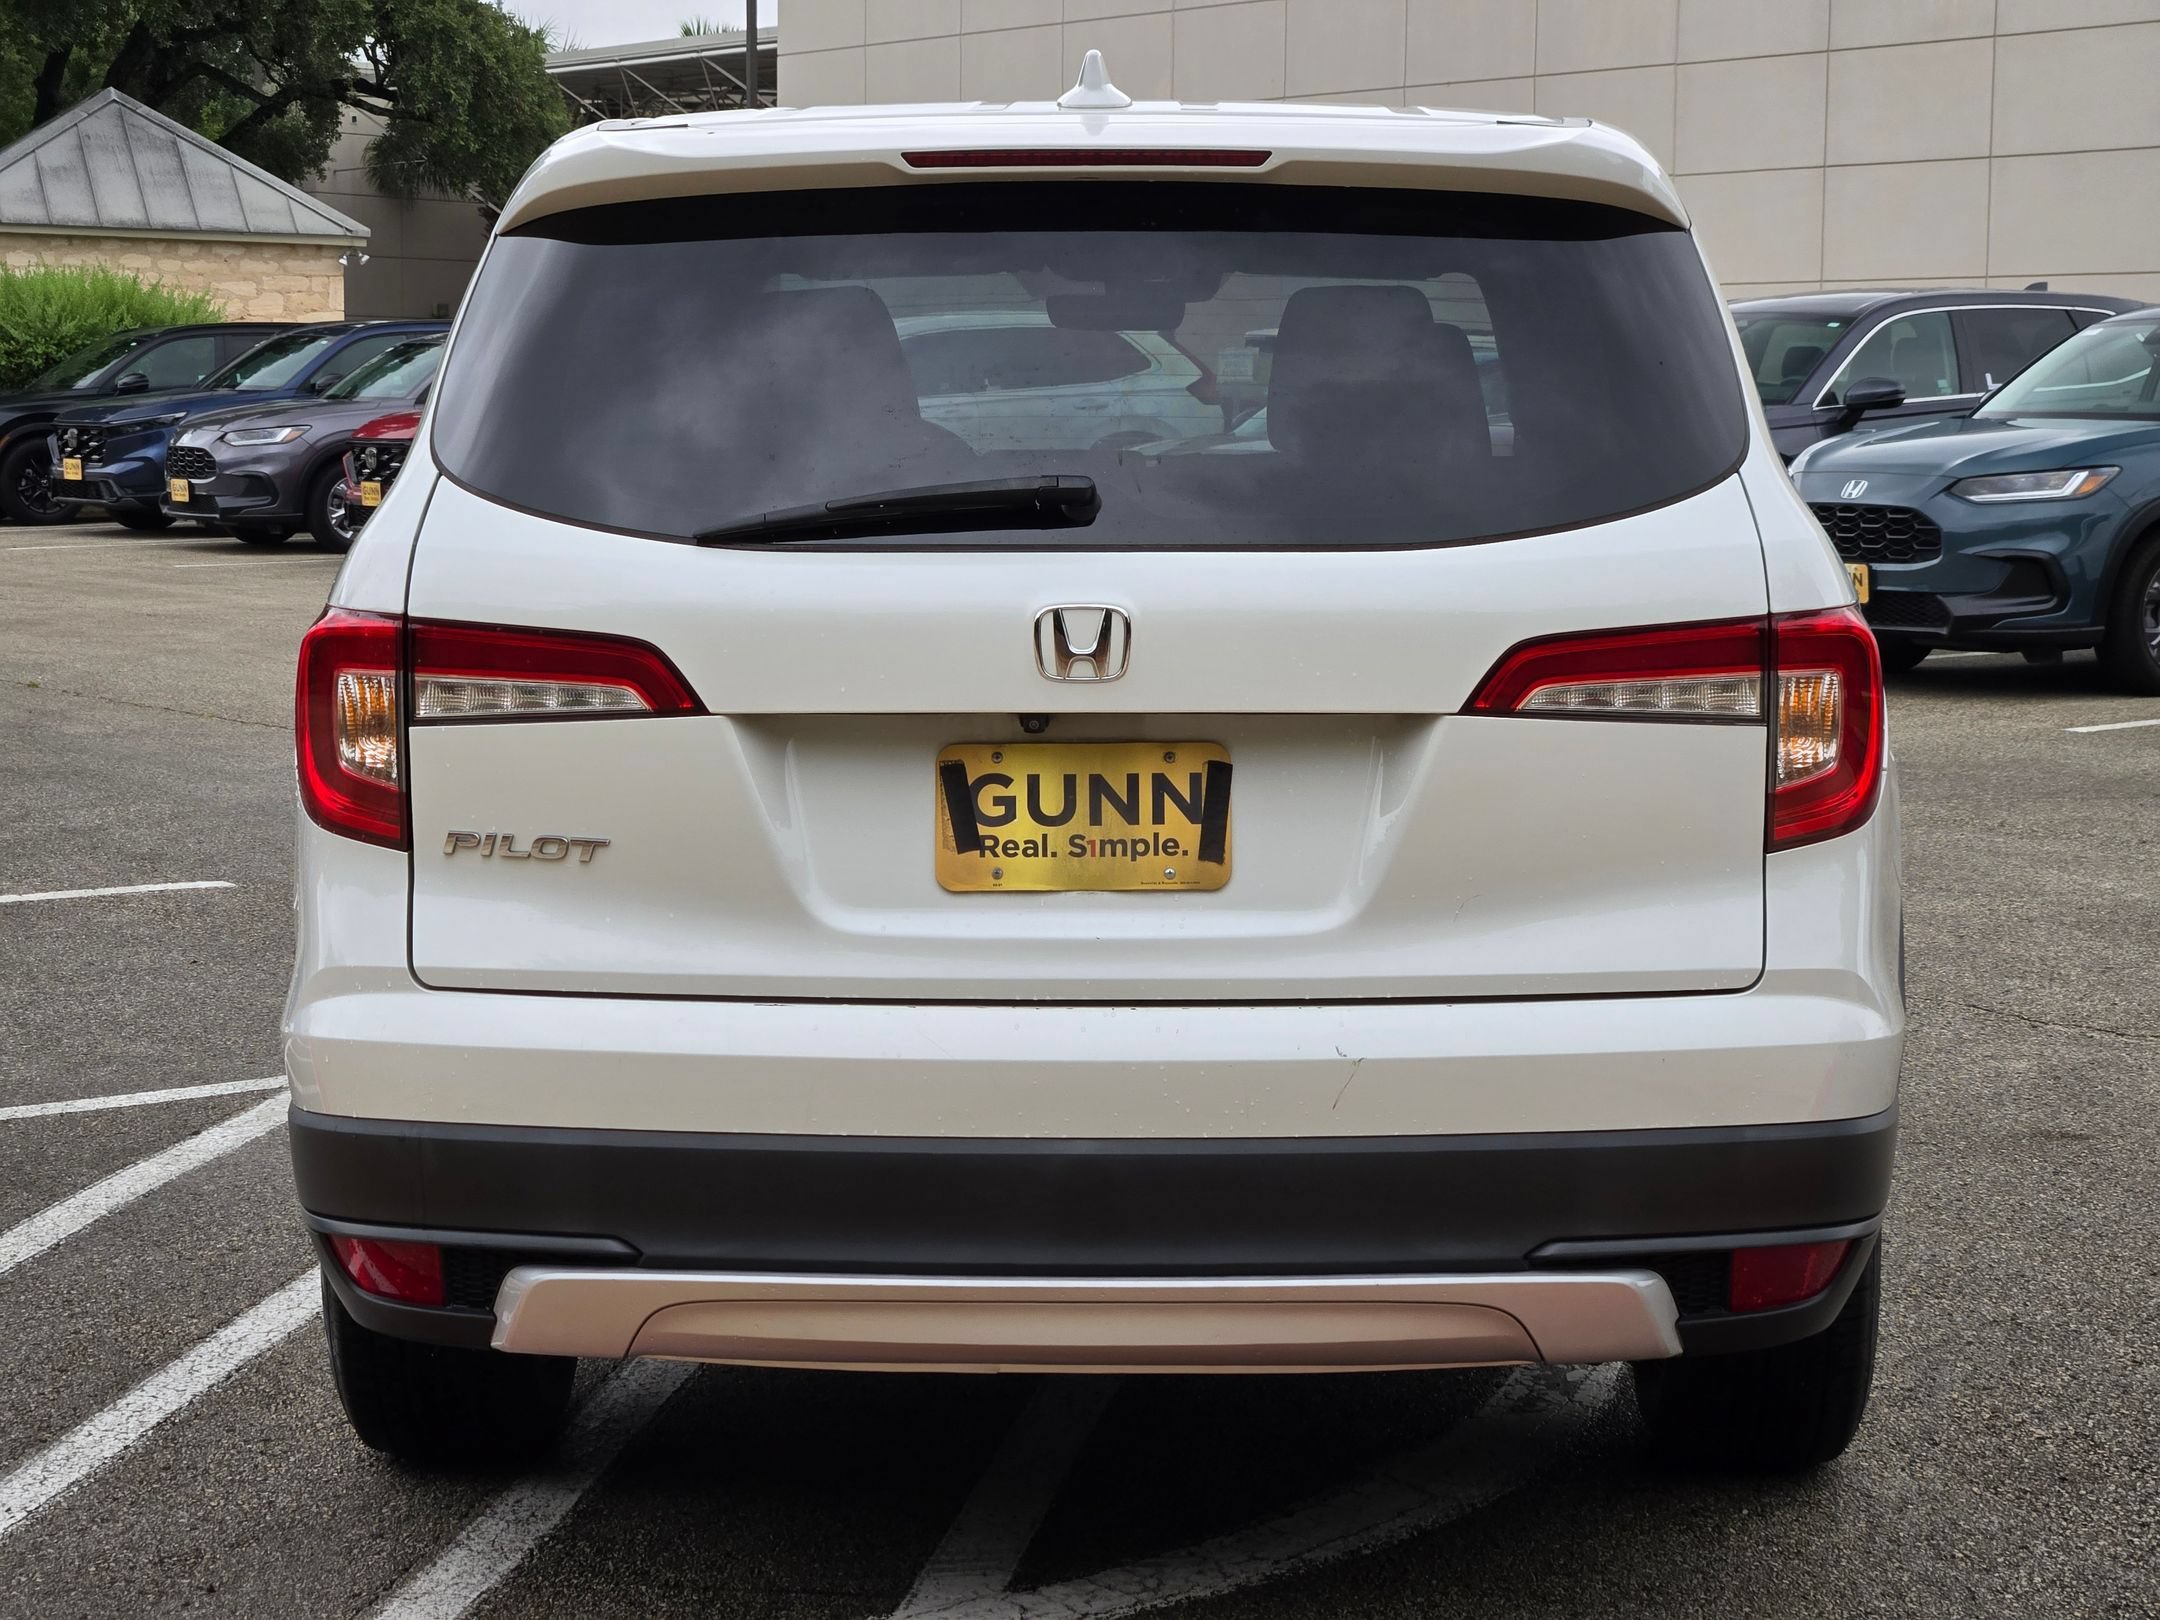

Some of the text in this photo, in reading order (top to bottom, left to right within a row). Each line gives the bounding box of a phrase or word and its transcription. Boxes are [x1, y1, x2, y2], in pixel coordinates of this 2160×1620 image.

[968, 773, 1203, 827] GUNN
[443, 830, 610, 863] PILOT
[979, 834, 1058, 858] Real.
